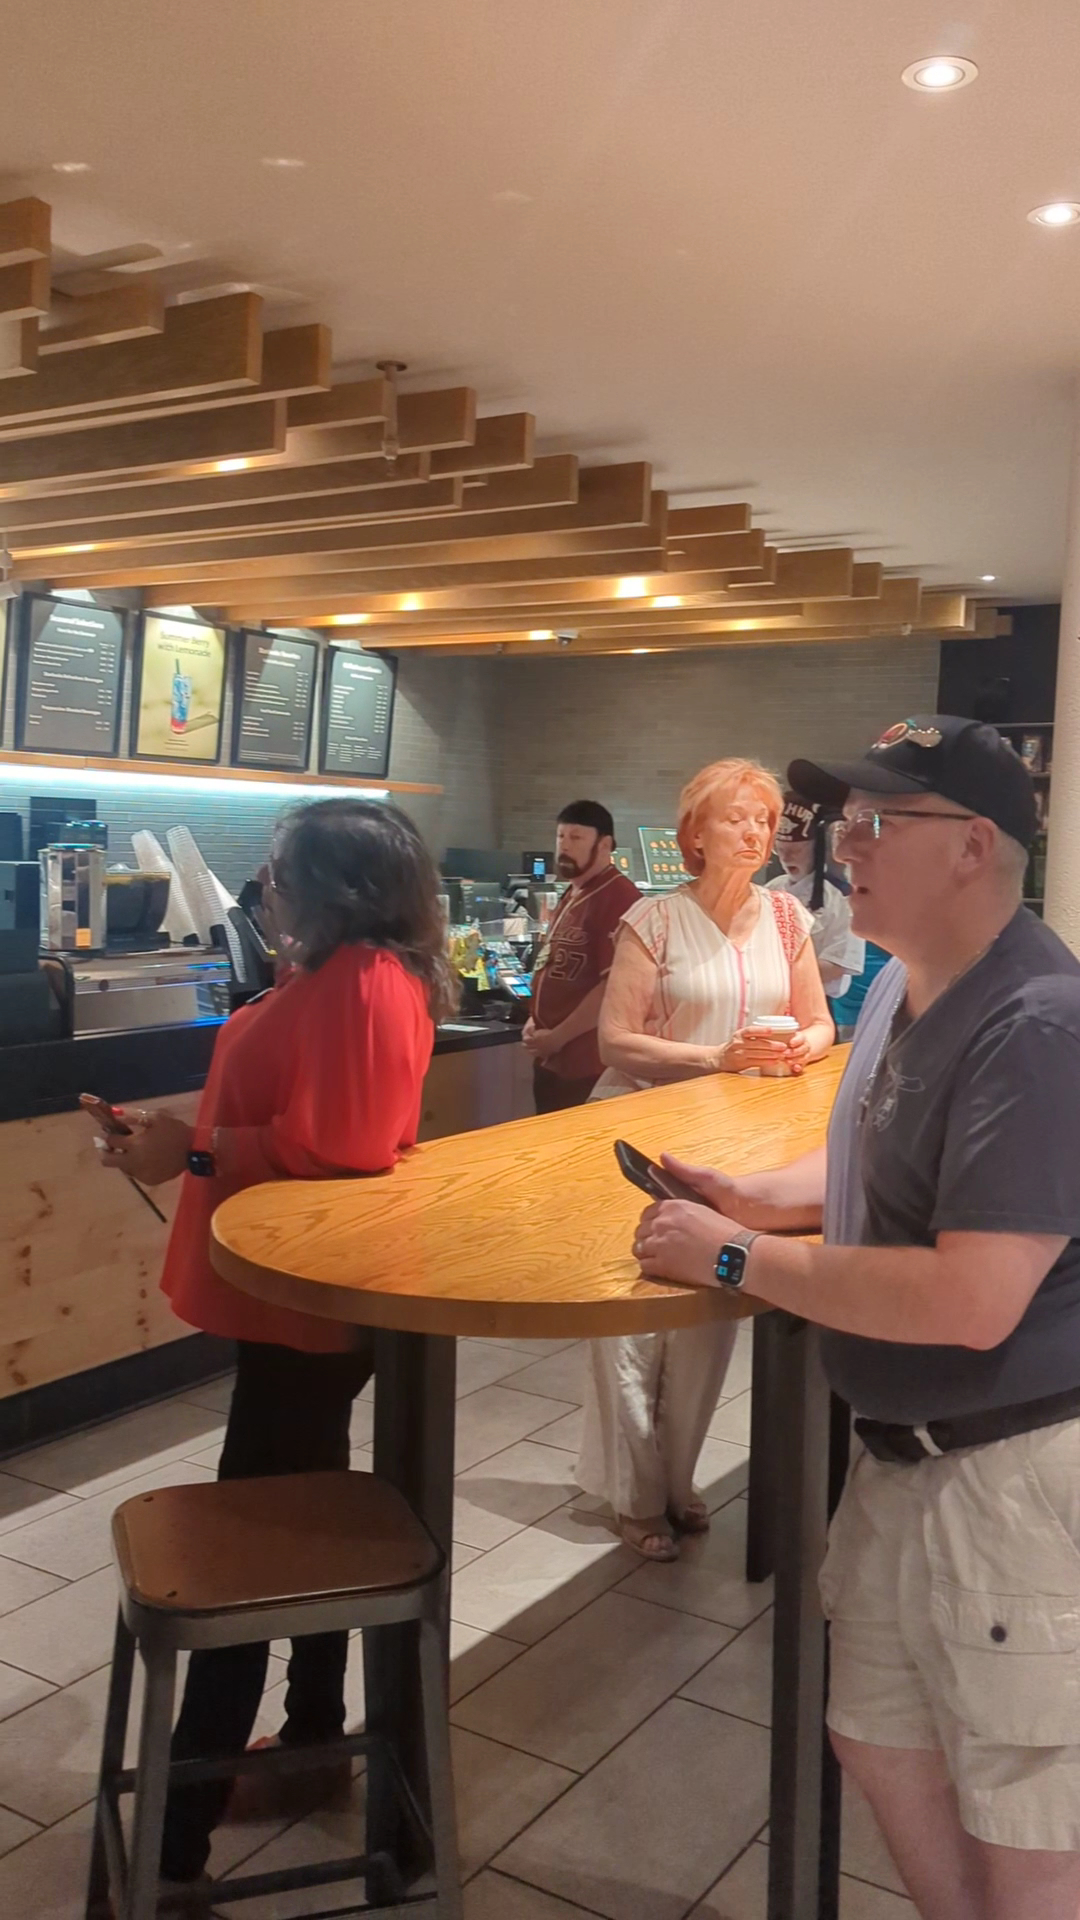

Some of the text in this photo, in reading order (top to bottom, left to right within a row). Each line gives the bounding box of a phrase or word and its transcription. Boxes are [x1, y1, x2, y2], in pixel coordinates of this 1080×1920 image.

[157, 642, 211, 657] with Lemonade
[191, 636, 209, 649] Berry
[548, 948, 588, 981] 27
